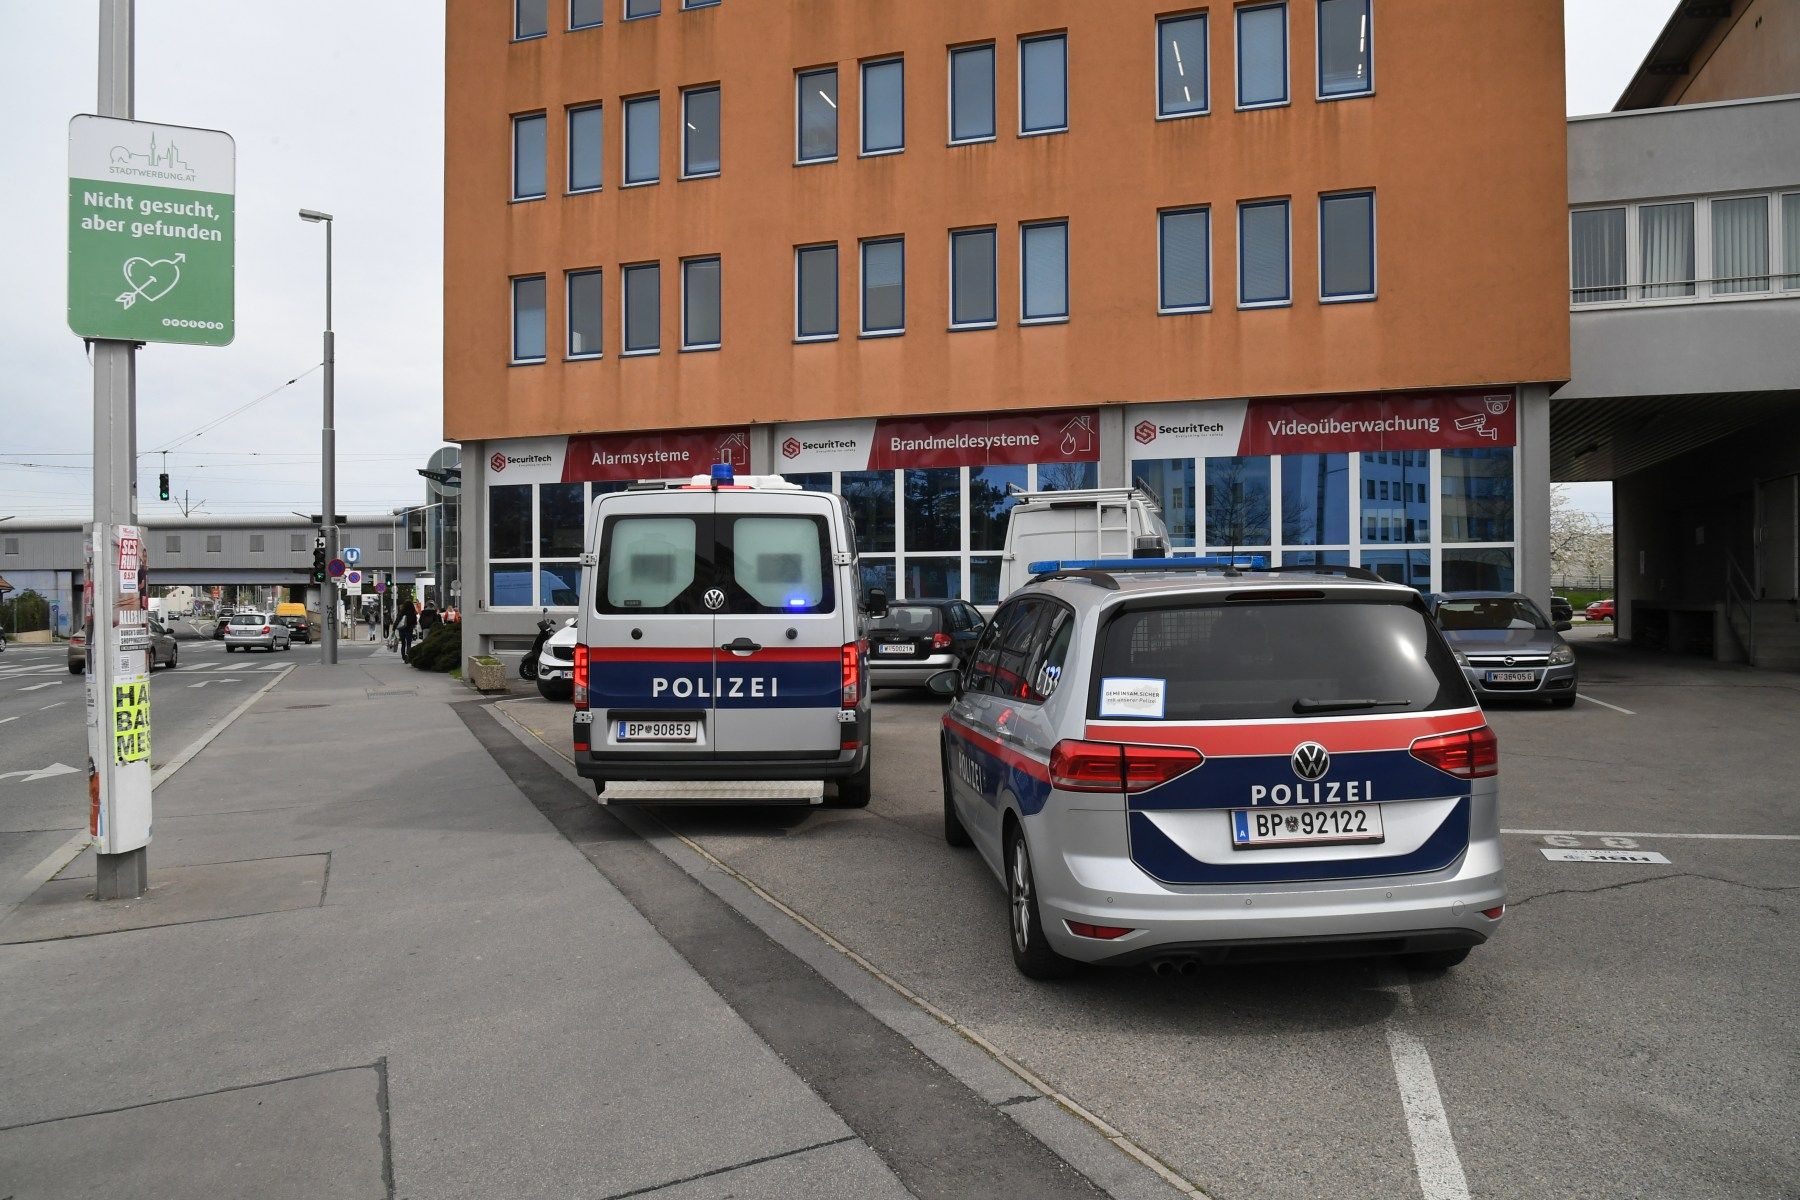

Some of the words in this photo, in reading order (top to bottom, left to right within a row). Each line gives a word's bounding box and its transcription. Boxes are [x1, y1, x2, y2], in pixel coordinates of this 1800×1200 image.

[109, 166, 196, 182] STADTWERBUNG.AT
[84, 191, 134, 210] Nicht
[140, 199, 220, 221] gesucht,
[81, 215, 126, 232] aber
[131, 219, 222, 242] gefunden
[1159, 422, 1224, 434] SecuritTech
[1267, 415, 1440, 437] Videoüberwachung
[802, 440, 856, 450] SecuritTech
[891, 433, 1040, 452] Brandmeldesysteme
[507, 454, 552, 464] SecuritTech
[592, 450, 690, 466] Alarmsysteme
[121, 539, 137, 555] SCS
[120, 555, 137, 570] RUN
[652, 677, 778, 698] POLIZEI
[629, 723, 644, 736] BP
[653, 723, 691, 736] 90859
[1251, 780, 1372, 806] POLIZEI
[1256, 812, 1283, 837] BP
[1301, 809, 1368, 835] 92122
